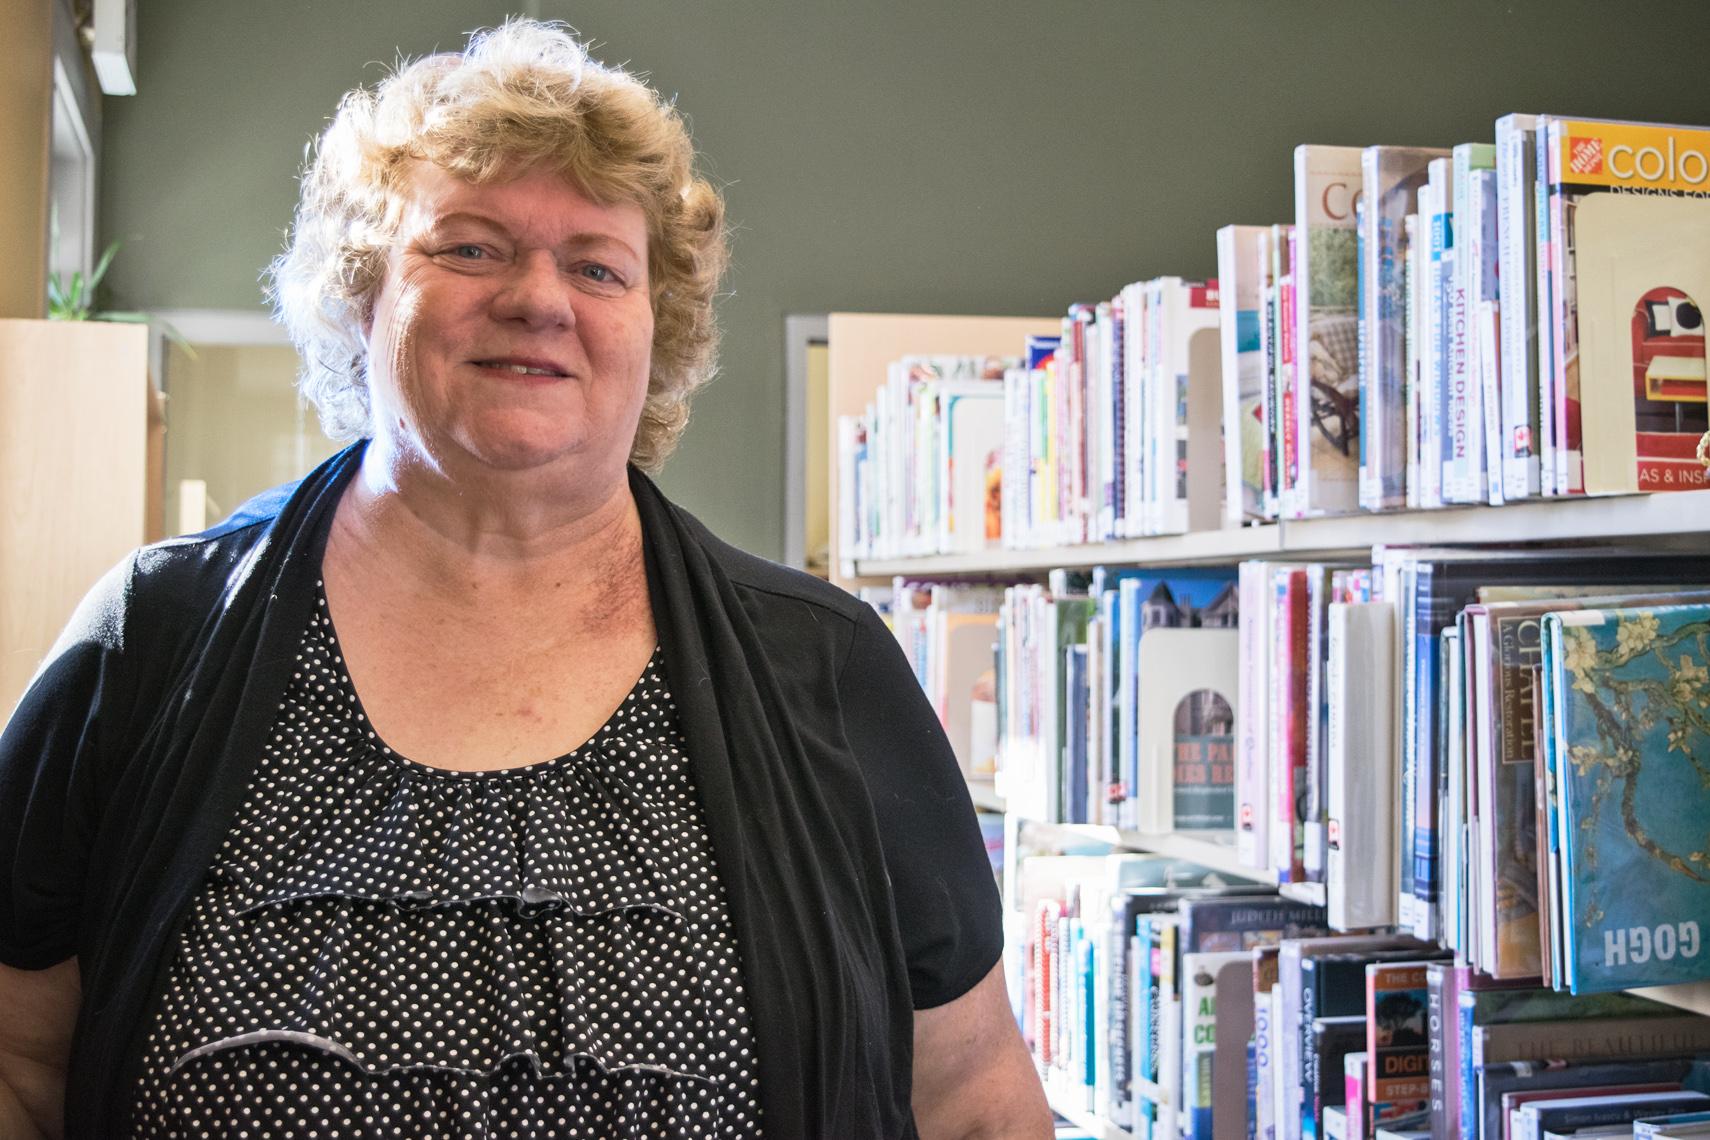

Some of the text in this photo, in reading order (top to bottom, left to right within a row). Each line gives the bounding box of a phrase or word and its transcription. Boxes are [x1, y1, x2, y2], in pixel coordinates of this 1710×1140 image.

[1455, 288, 1466, 375] KITCHEN
[1454, 380, 1465, 459] DESIGN
[1663, 468, 1674, 484] &
[1502, 633, 1516, 687] Glorious
[1503, 689, 1517, 760] Restoration
[1604, 920, 1700, 967] GOGH
[1386, 972, 1408, 985] THE
[1429, 993, 1443, 1112] HORSES
